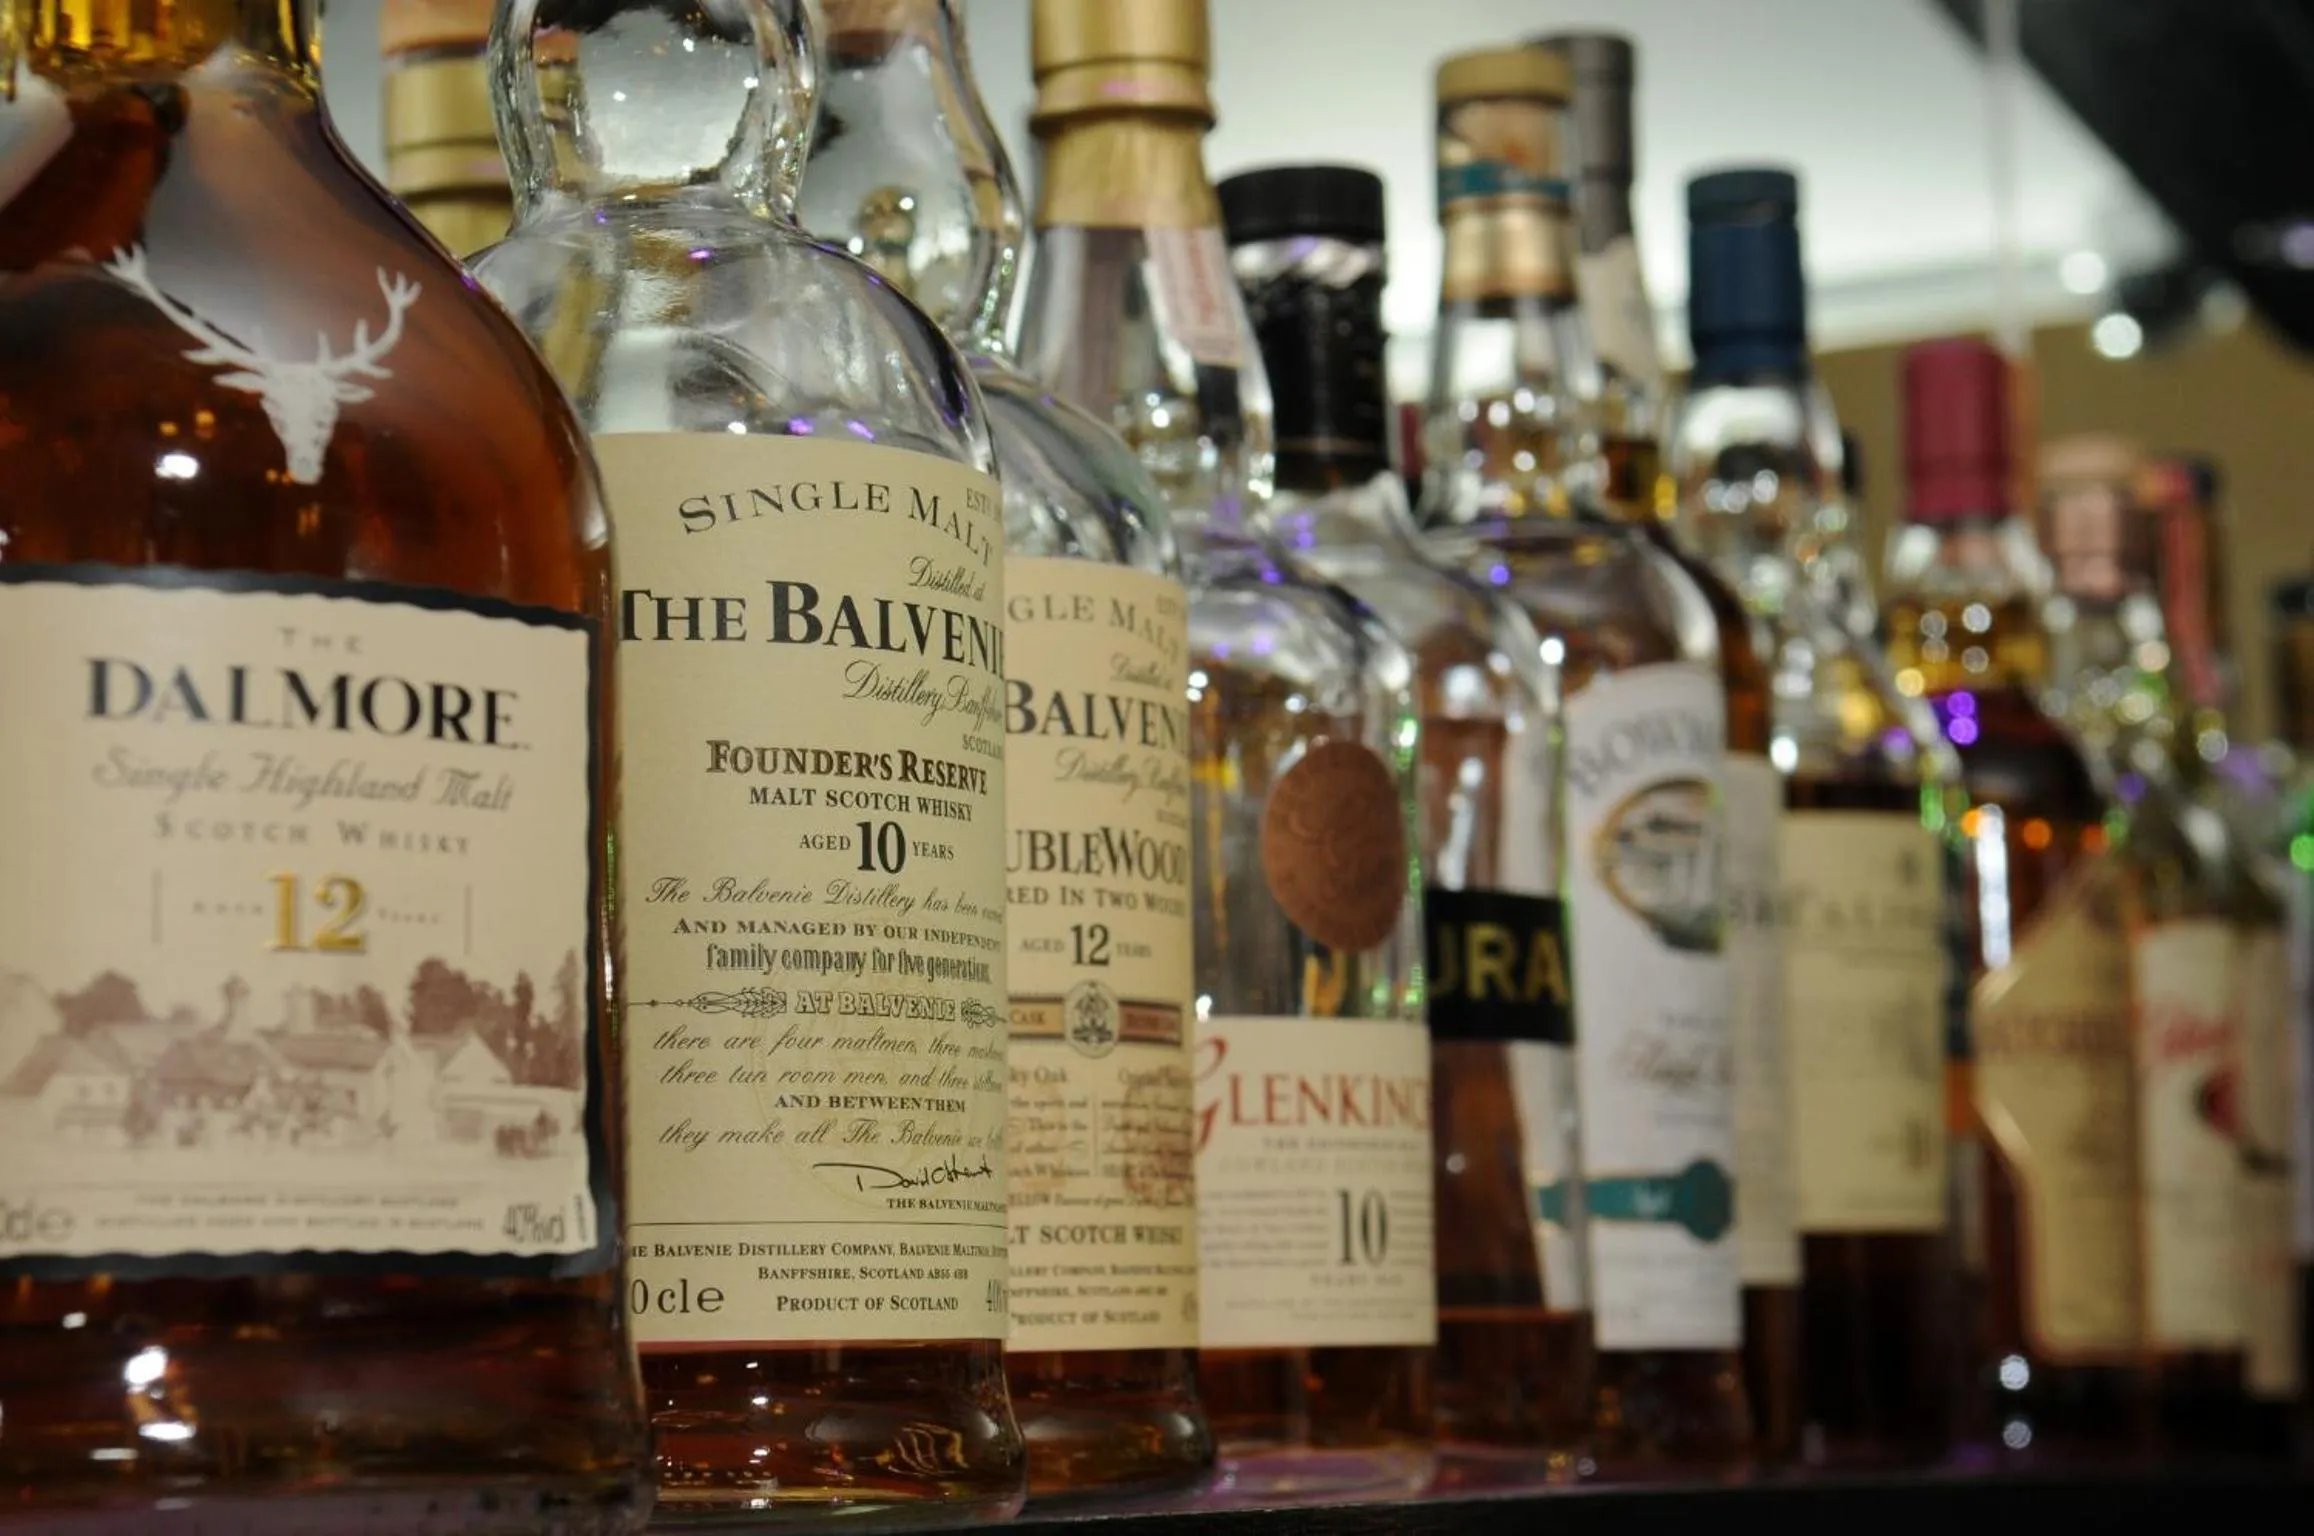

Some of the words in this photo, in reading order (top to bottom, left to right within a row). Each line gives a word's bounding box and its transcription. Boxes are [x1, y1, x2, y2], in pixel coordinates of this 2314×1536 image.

[679, 480, 892, 534] SINGLE
[907, 486, 994, 567] MALT
[908, 556, 975, 598] Distilled
[622, 589, 747, 642] THE
[279, 627, 363, 653] THE
[86, 656, 524, 750] DALMORE
[93, 746, 230, 804] Single
[237, 752, 423, 812] Highland
[436, 768, 515, 812] Malt
[706, 740, 893, 781] FOUNDER'S
[897, 749, 988, 796] RESERVE
[749, 787, 817, 806] MALT
[825, 789, 911, 814] SCOTCH
[916, 797, 973, 823] WHISKY
[154, 815, 310, 845] SCOTCH
[799, 834, 851, 851] AGED
[855, 820, 907, 874] 10
[911, 840, 955, 861] YEARS
[263, 870, 367, 955] 12
[645, 876, 690, 904] The
[701, 877, 813, 904] Balvenie
[823, 879, 916, 917] Distillery
[921, 886, 949, 913] has
[1060, 886, 1084, 906] IN
[1095, 889, 1138, 911] TWO
[673, 917, 728, 935] AND
[737, 919, 847, 937] MANAGED
[853, 923, 877, 938] BY
[883, 924, 918, 940] OUR
[1019, 937, 1064, 953] AGED
[1069, 923, 1110, 967] 12
[706, 943, 777, 977] family
[781, 946, 866, 978] company
[871, 946, 895, 974] for
[795, 991, 833, 1015] AT
[838, 991, 956, 1022] BALVENIE
[653, 1023, 712, 1051] there
[723, 1035, 762, 1052] are
[767, 1025, 824, 1056] four
[928, 1030, 961, 1057] three
[659, 1059, 718, 1085] three
[728, 1065, 768, 1084] tun
[777, 1067, 837, 1085] room
[899, 1065, 938, 1088] and
[938, 1064, 970, 1091] three
[774, 1094, 822, 1109] AND
[827, 1095, 922, 1112] BETWEEN
[925, 1098, 966, 1113] THEM
[658, 1118, 707, 1153] they
[718, 1122, 785, 1144] make
[794, 1118, 838, 1144] all
[842, 1118, 881, 1145] The
[890, 1119, 963, 1147] Balvenie
[886, 1198, 916, 1210] THE
[918, 1198, 970, 1211] BALVENIE
[1039, 1225, 1127, 1245] SCOTCH
[1336, 1186, 1389, 1267] 10
[653, 1242, 733, 1258] BALVENIE
[738, 1243, 826, 1257] DISTILLERY
[831, 1242, 896, 1258] COMPANY,
[900, 1243, 951, 1257] BALVENIE
[758, 1267, 857, 1281] BANFFSHIRE,
[859, 1266, 924, 1280] SCOTLAND
[776, 1295, 859, 1312] PRODUCT
[864, 1295, 886, 1312] OF
[890, 1295, 959, 1312] SCOTLAND
